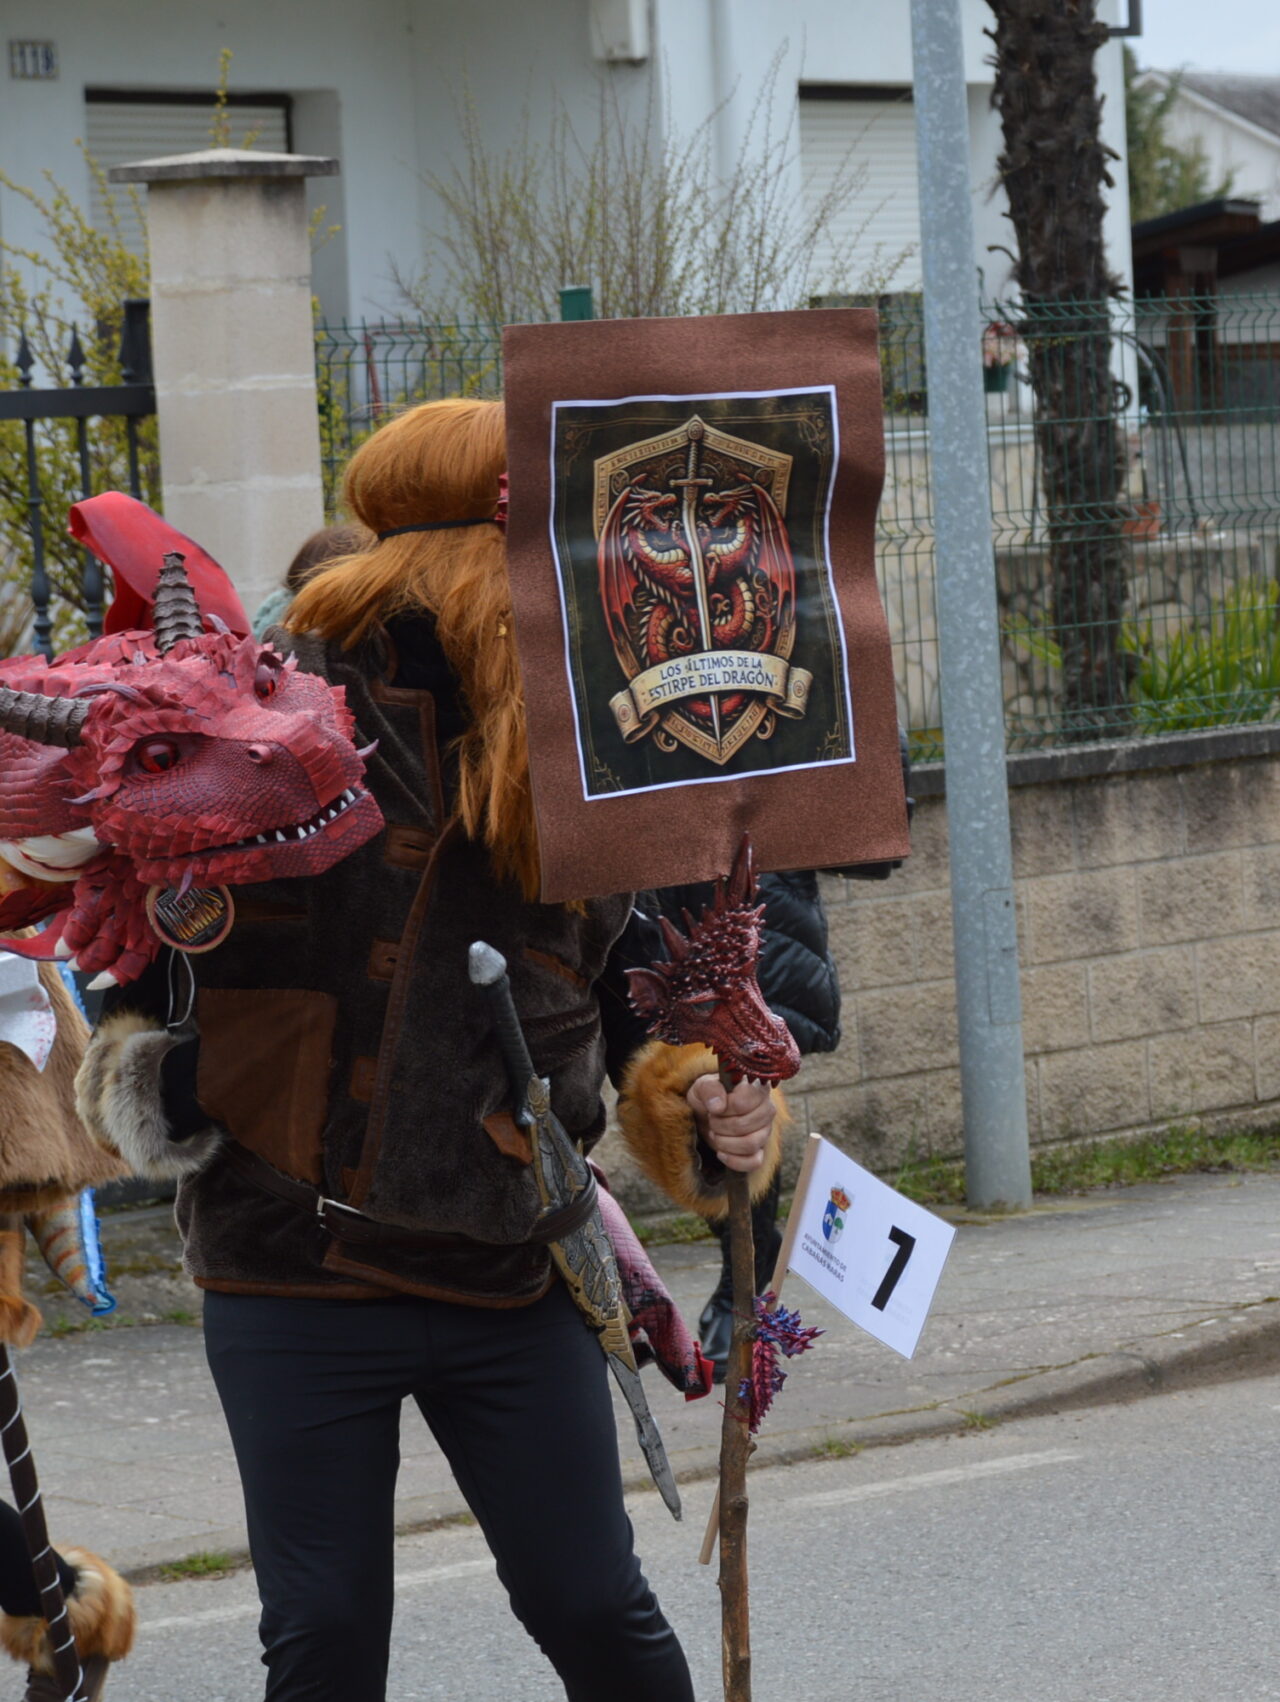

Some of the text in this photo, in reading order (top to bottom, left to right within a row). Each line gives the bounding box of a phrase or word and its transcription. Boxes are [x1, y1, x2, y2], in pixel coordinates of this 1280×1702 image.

[648, 669, 774, 702] ESTIRPE DEL DRAGÓN
[660, 664, 682, 681] LOS
[737, 656, 749, 668] DE
[751, 658, 762, 669] LA
[804, 1232, 847, 1272] AYUNTAMIENTO DE
[870, 1225, 917, 1312] 7
